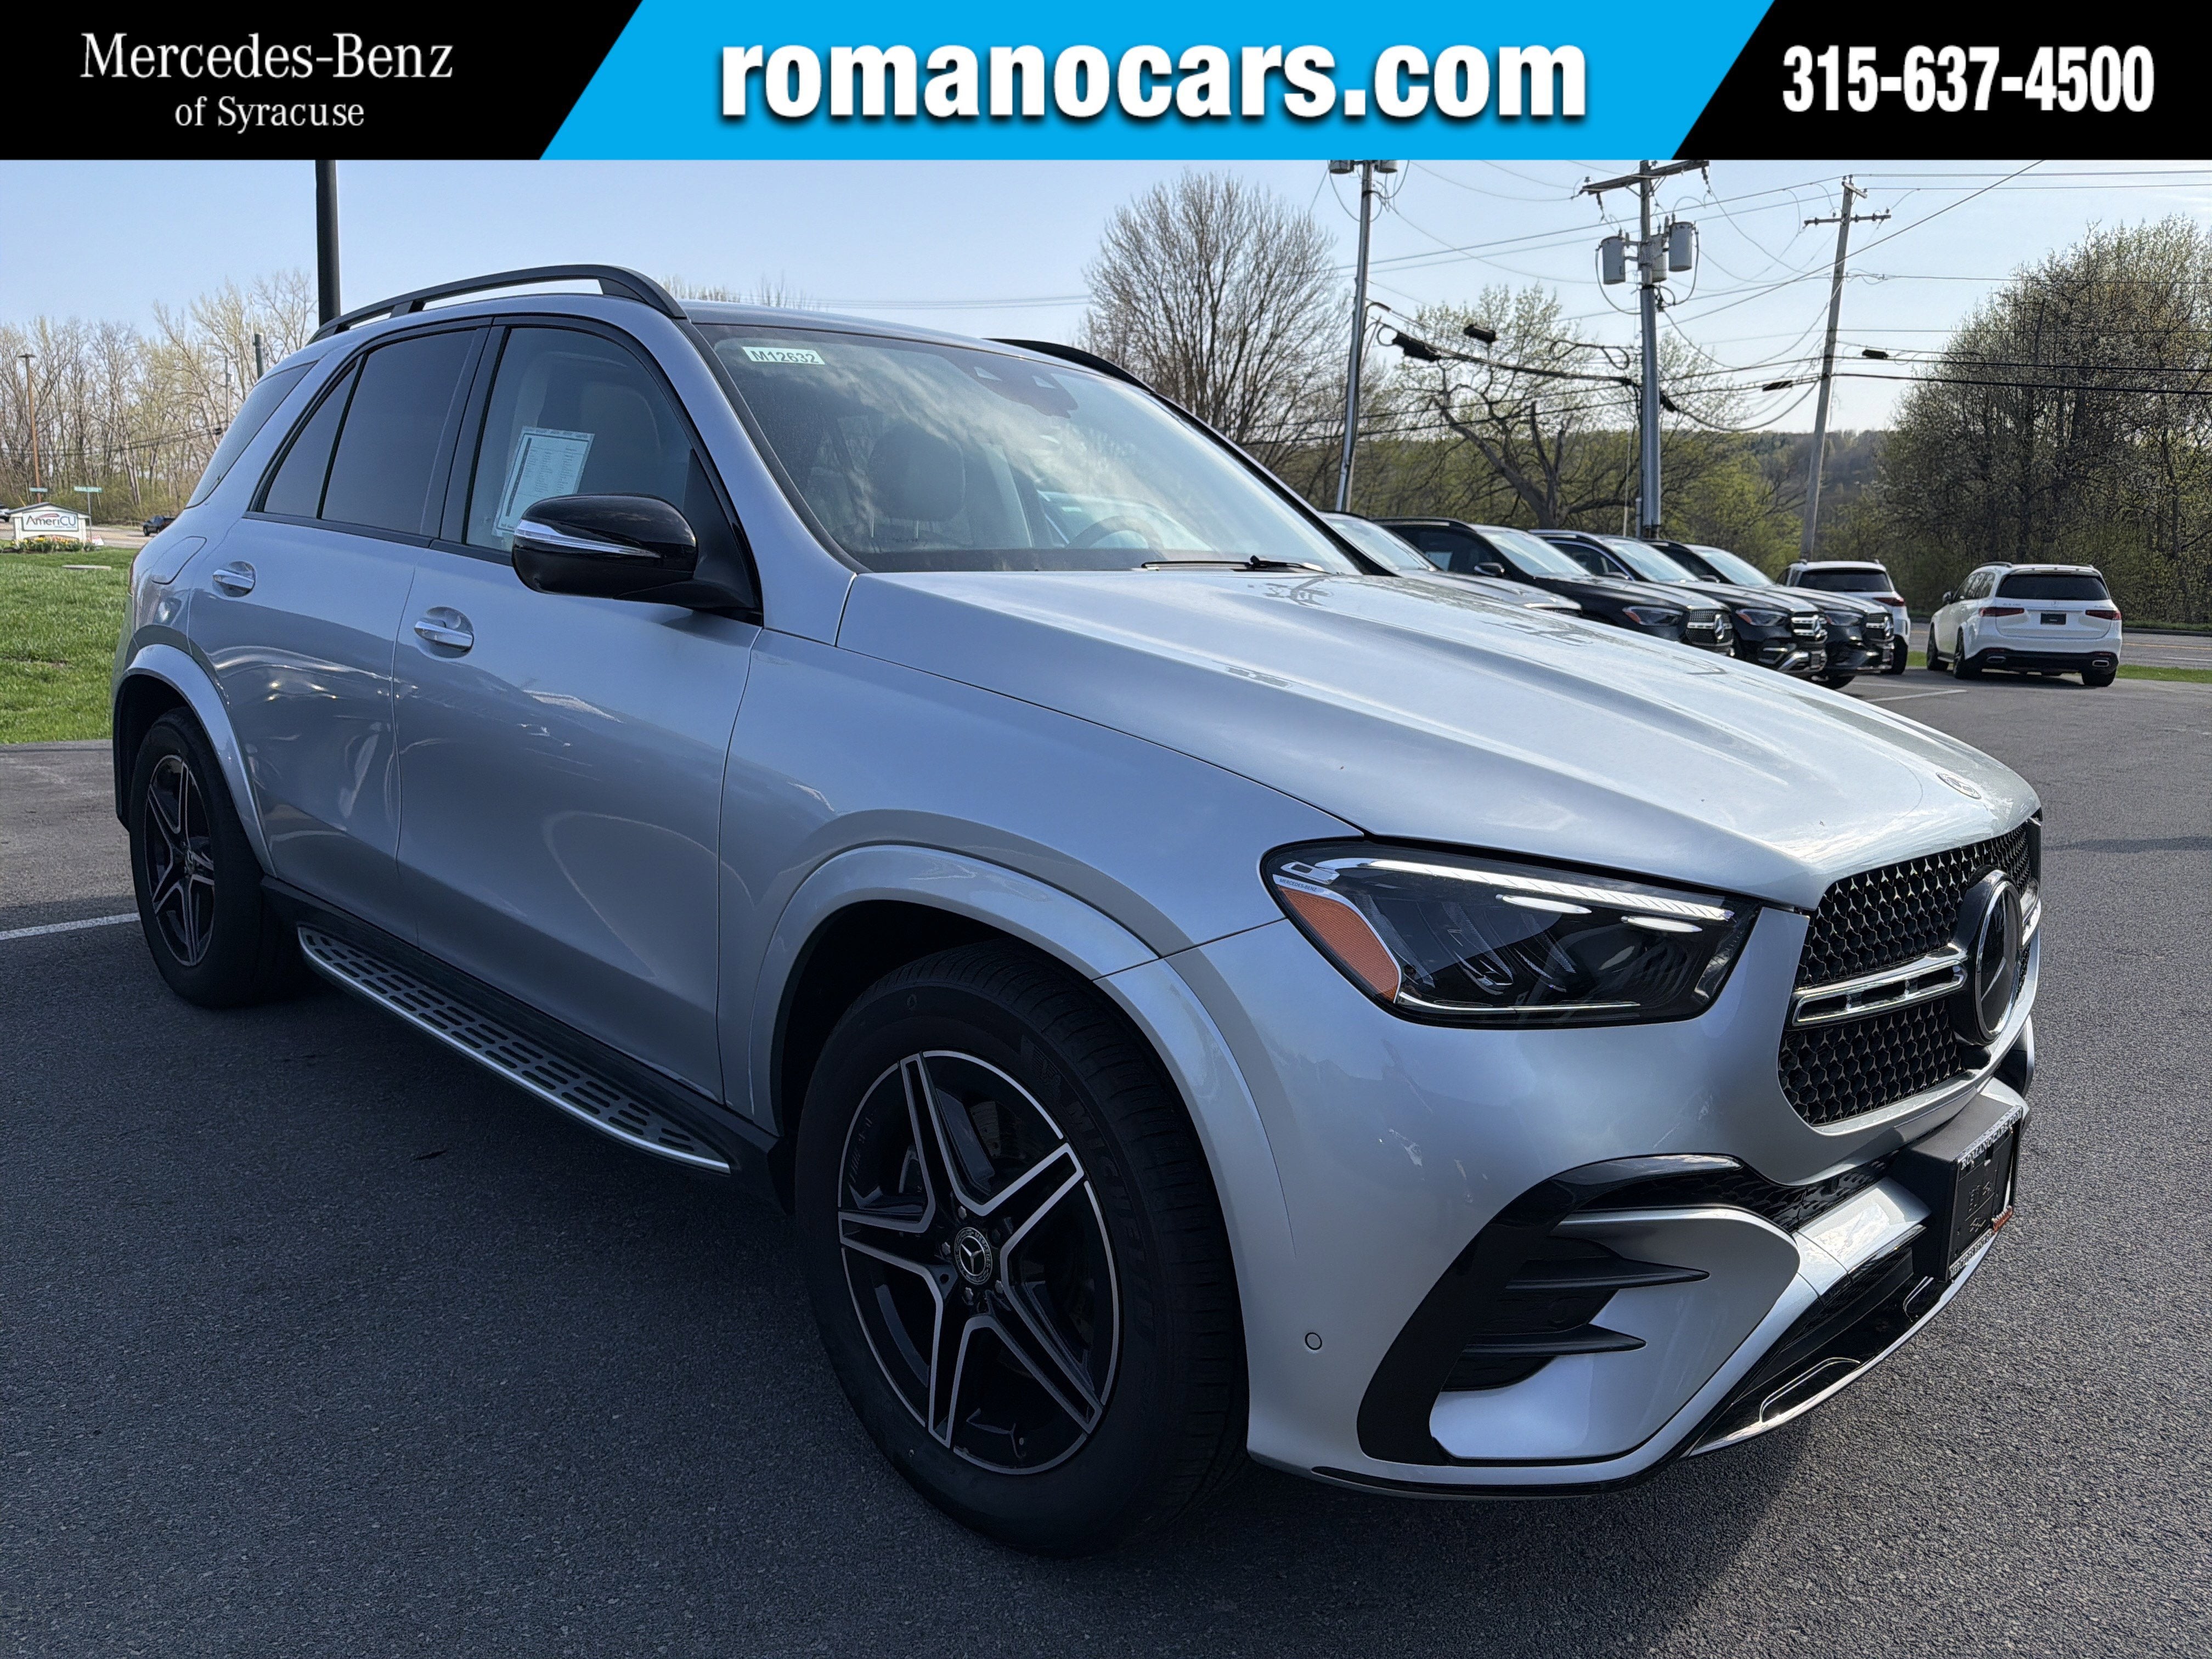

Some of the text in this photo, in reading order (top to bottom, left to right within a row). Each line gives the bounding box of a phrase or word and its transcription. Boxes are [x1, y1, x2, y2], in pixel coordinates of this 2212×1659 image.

[751, 351, 819, 363] M12632
[26, 514, 76, 526] AmeriCU
[1279, 878, 1317, 892] MERCEDES-BENZ
